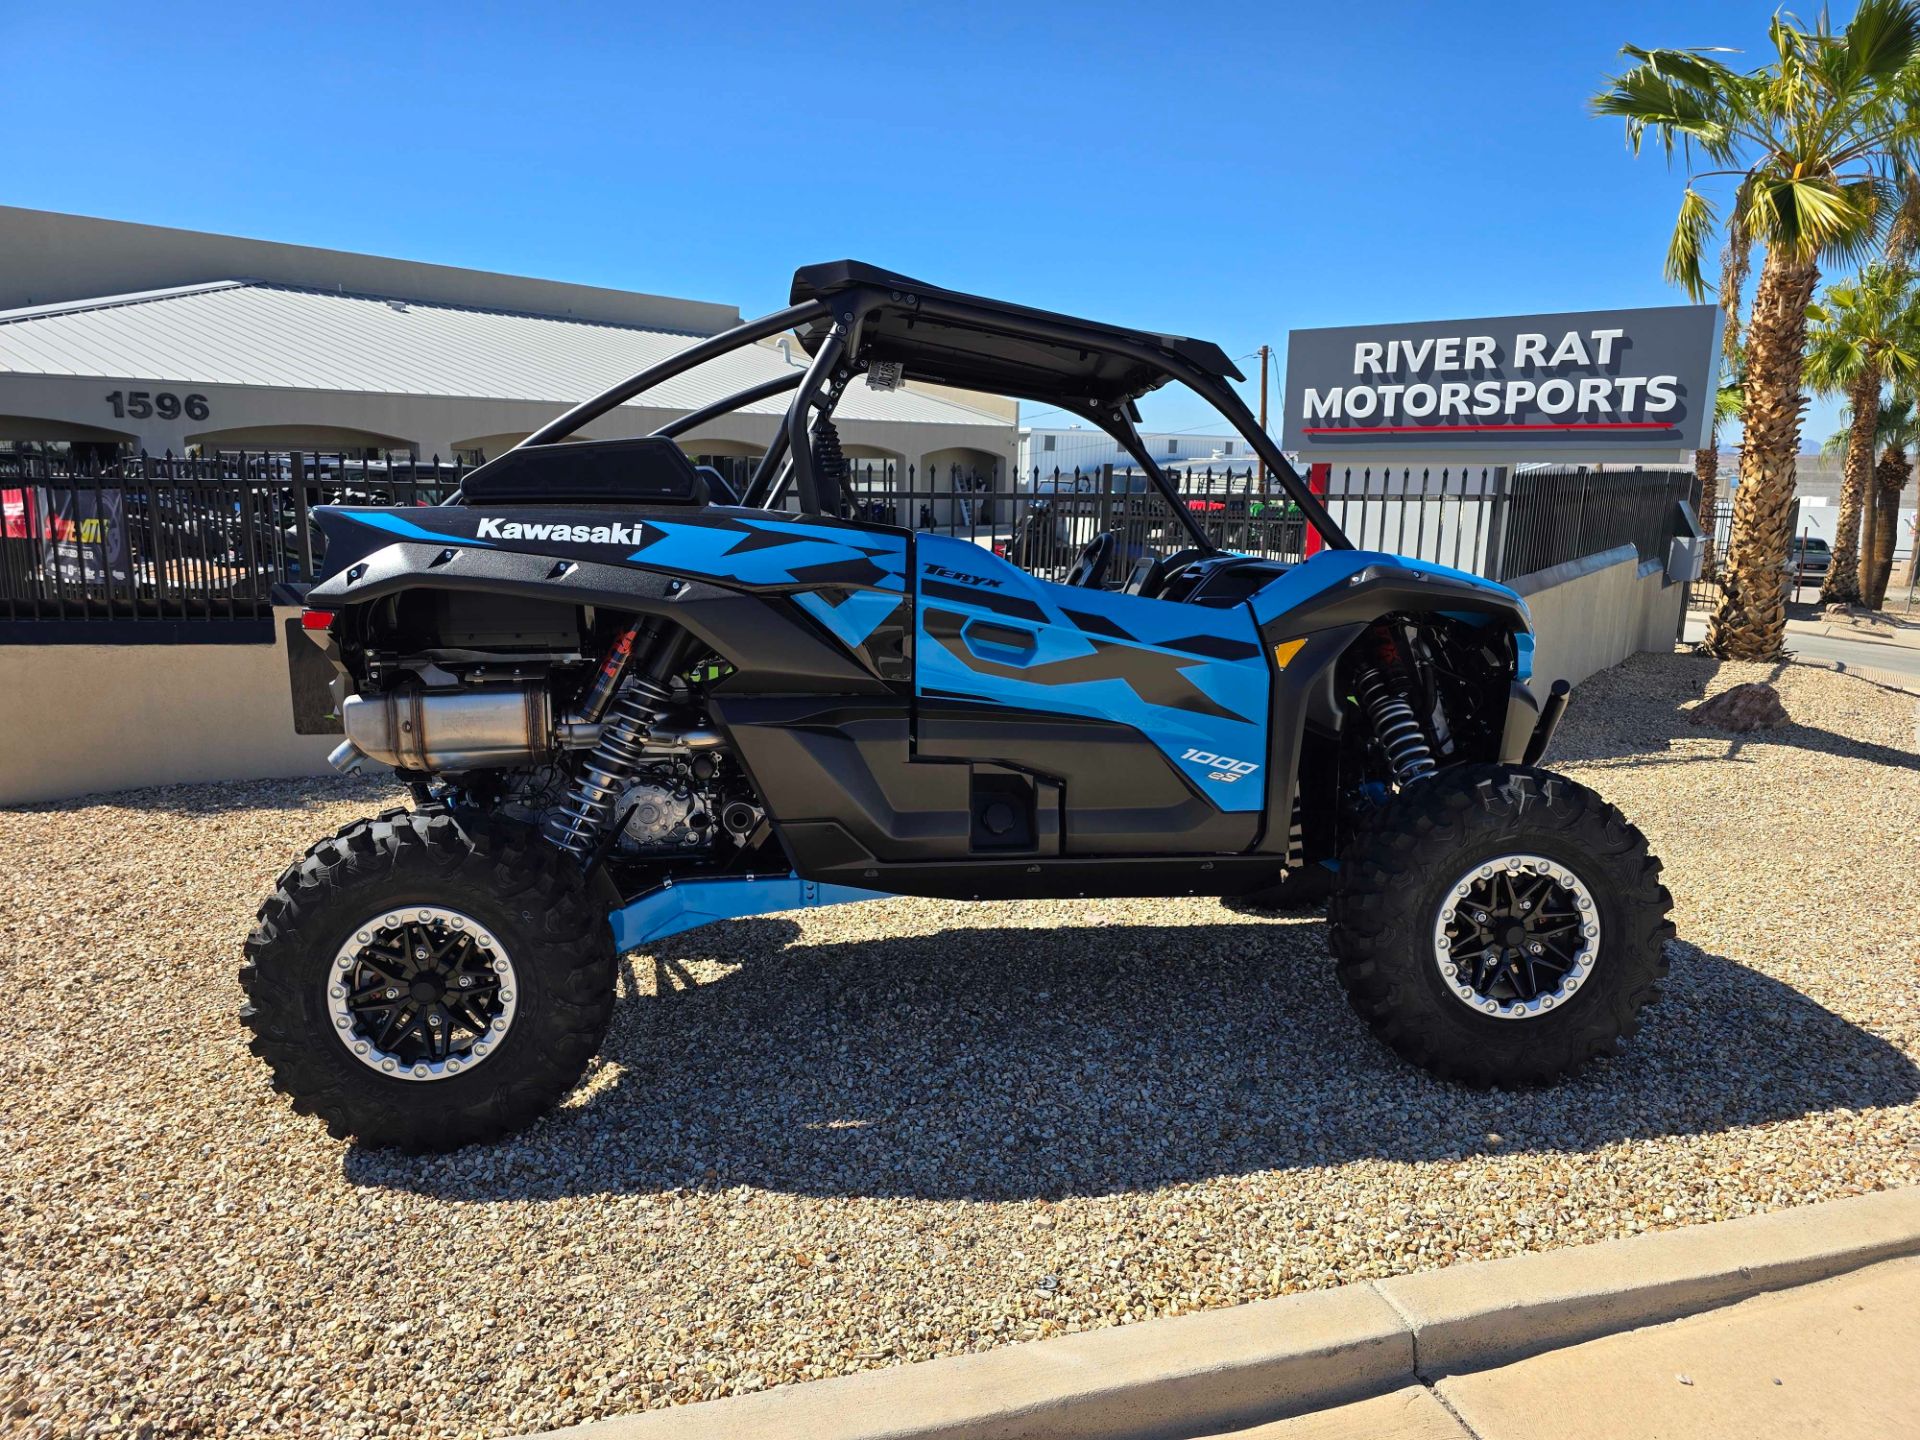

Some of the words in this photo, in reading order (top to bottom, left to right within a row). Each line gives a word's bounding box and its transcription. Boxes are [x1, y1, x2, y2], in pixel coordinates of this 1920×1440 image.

[1354, 336, 1496, 374] RIVER
[1514, 329, 1624, 368] RAT
[105, 391, 210, 421] 1596
[1303, 376, 1678, 419] MOTORSPORTS
[476, 518, 643, 545] Kawasaki
[1180, 748, 1260, 774] 1000
